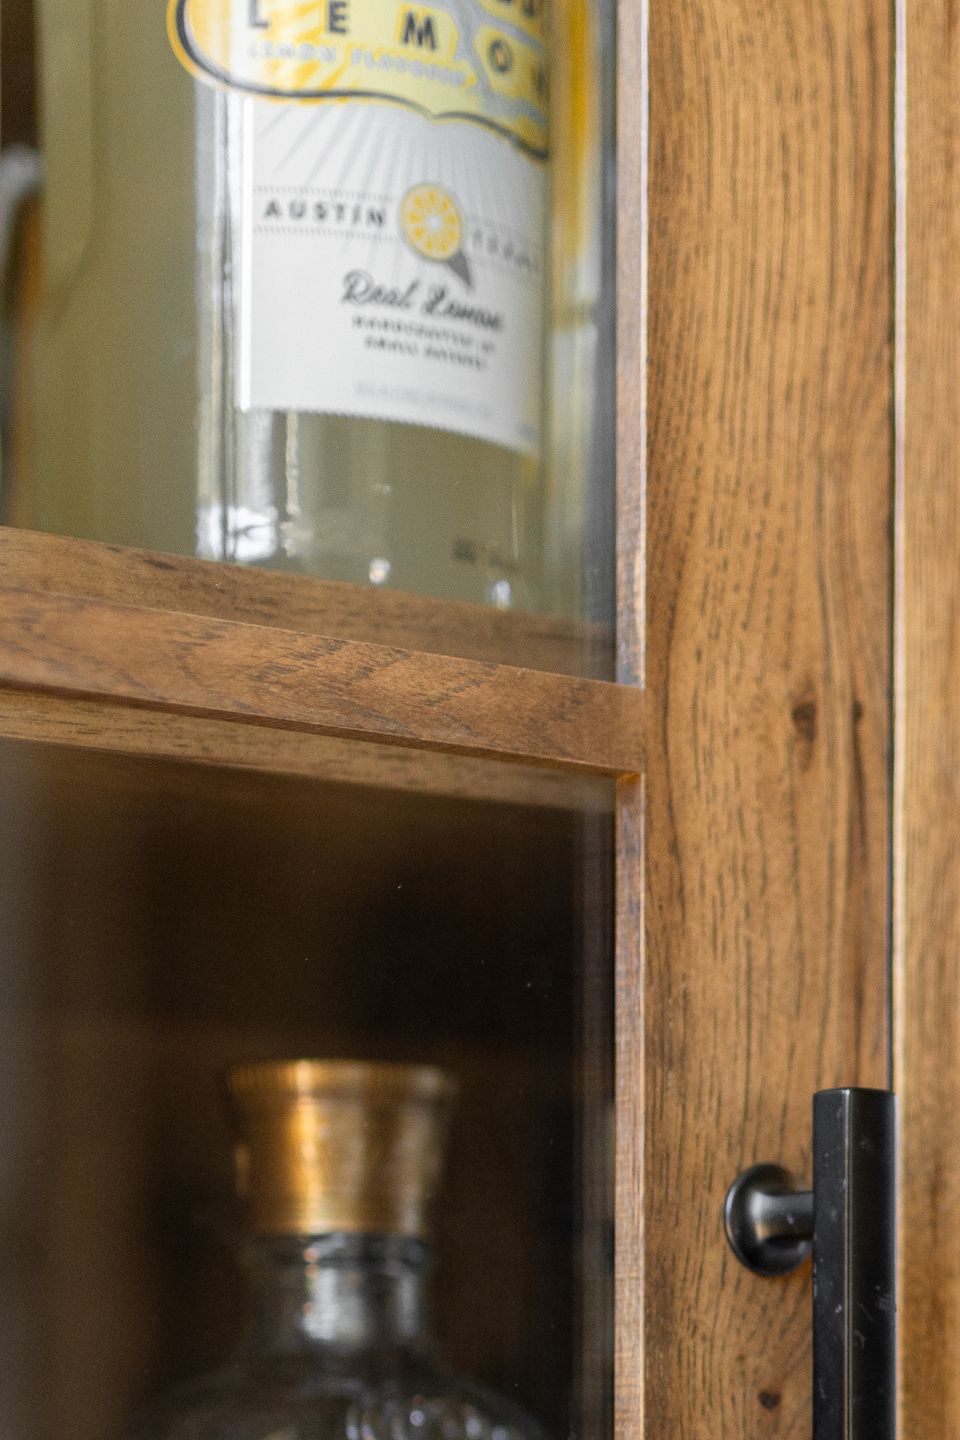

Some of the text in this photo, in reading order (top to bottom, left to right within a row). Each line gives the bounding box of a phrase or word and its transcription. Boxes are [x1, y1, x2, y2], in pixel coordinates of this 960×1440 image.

[264, 200, 386, 228] AUSTIN
[340, 270, 504, 331] Real Lemon
